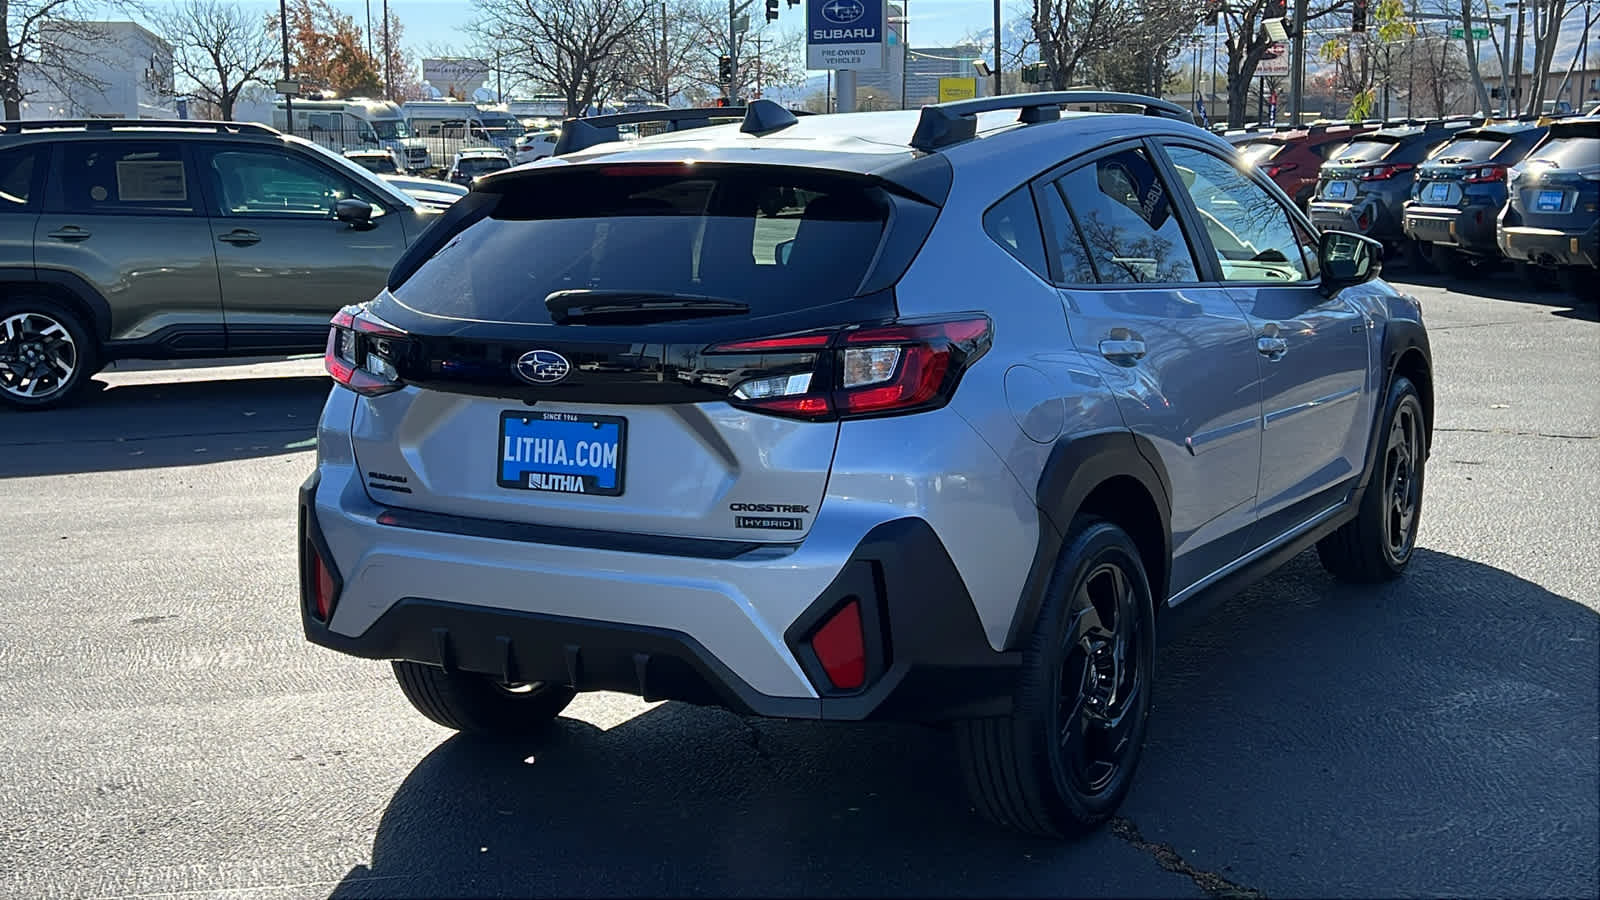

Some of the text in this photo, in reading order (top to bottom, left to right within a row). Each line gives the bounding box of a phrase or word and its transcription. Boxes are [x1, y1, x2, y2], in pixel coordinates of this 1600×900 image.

[813, 28, 875, 40] SUBARU
[821, 48, 866, 57] PRE-OWNED
[824, 56, 861, 65] VEHICLES
[543, 413, 562, 421] SINCE
[504, 435, 618, 469] LITHIA.COM
[540, 473, 585, 492] LITHIA
[729, 503, 811, 514] CROSSTREK
[744, 518, 792, 528] HYBRID
